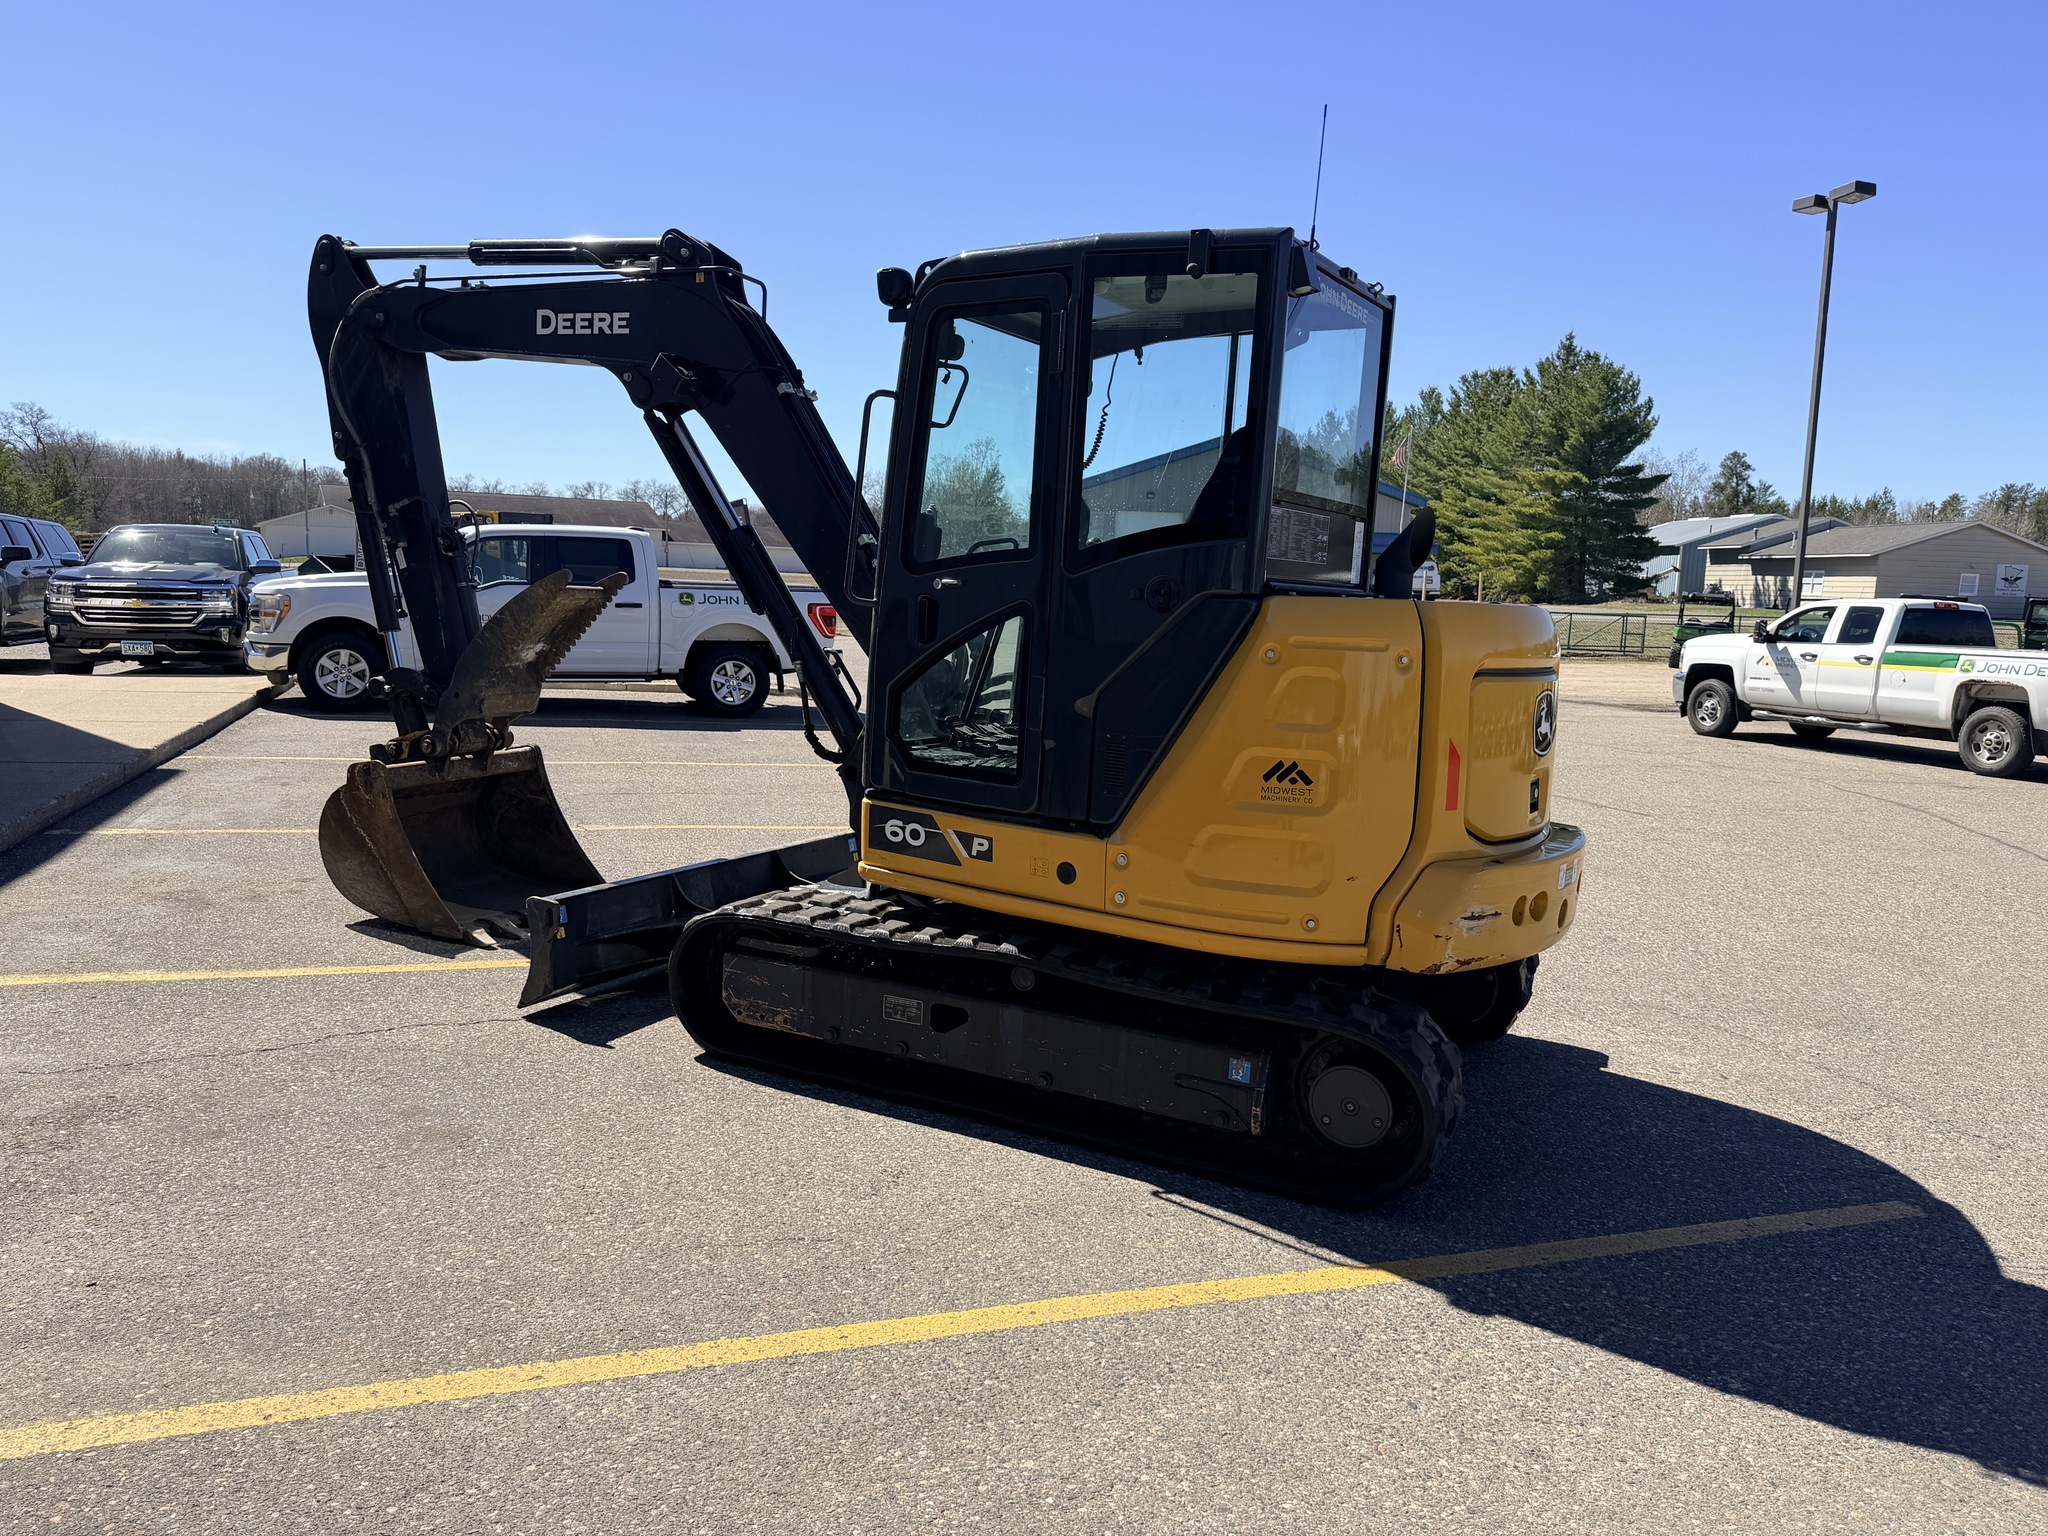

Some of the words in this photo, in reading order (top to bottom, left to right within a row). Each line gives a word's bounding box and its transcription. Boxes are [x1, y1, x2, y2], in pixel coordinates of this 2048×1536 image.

[1340, 291, 1369, 325] DEERE
[536, 308, 630, 335] DEERE
[698, 593, 740, 605] JOHN
[1775, 656, 1807, 664] MIDWEST
[1977, 661, 2022, 675] JOHN
[1260, 786, 1314, 797] MIDWEST
[1260, 794, 1301, 803] MACHINERY
[885, 819, 926, 847] 60
[971, 837, 989, 857] P
